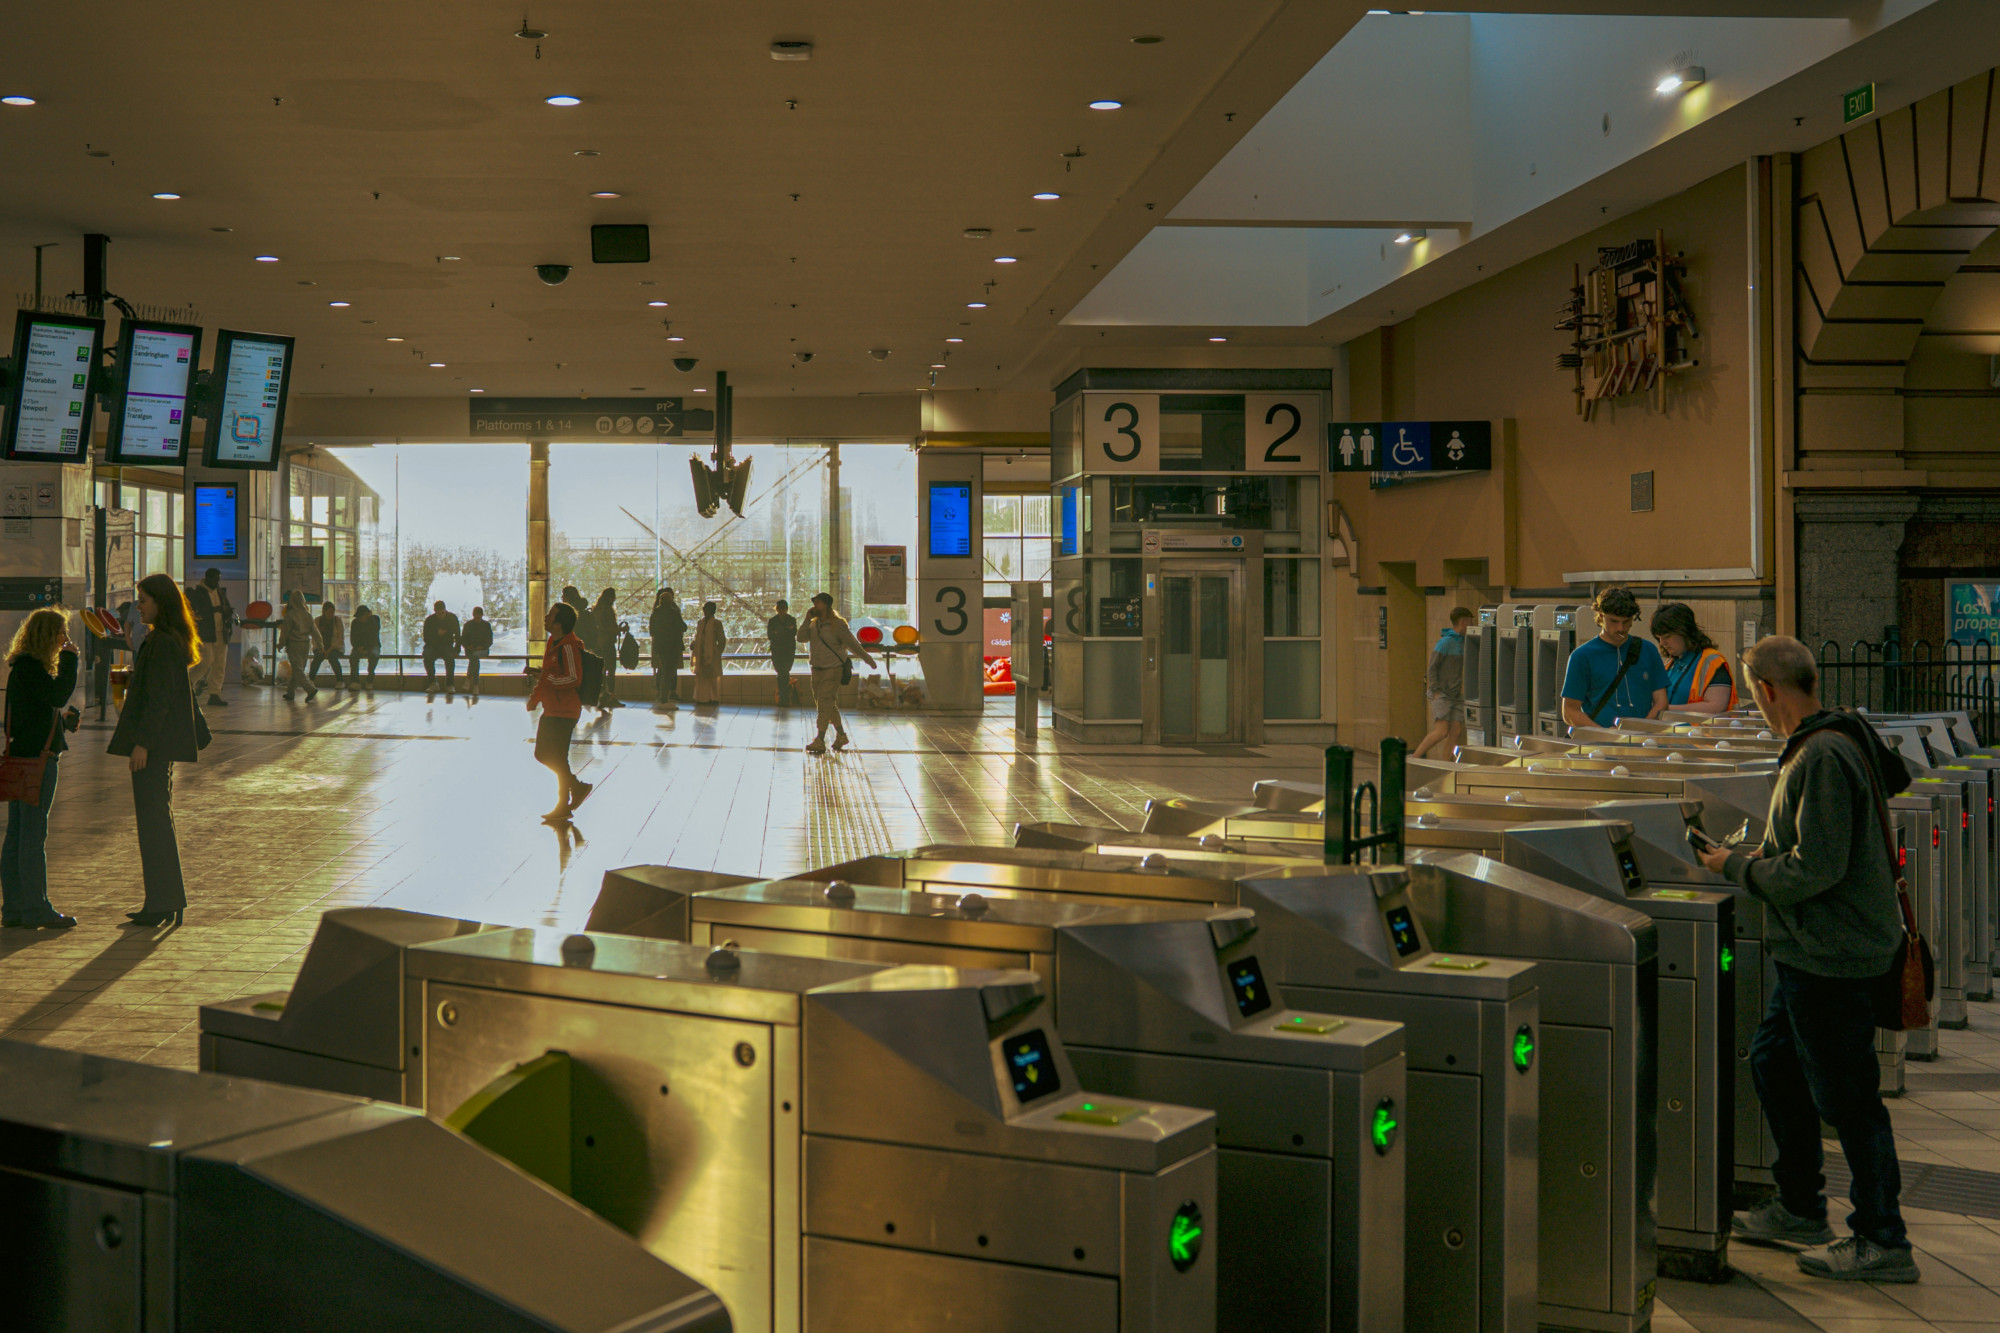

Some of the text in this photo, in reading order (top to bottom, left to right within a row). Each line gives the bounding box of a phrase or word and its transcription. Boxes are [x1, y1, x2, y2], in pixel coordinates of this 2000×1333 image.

[1850, 92, 1867, 116] EXIT
[134, 350, 169, 359] Sandringham
[26, 376, 56, 384] Moorabbin
[127, 412, 152, 420] Traralgon
[476, 419, 572, 431] Platforms 1 & 14
[1102, 402, 1142, 462] 3
[1264, 403, 1301, 462] 2
[934, 586, 968, 636] 3
